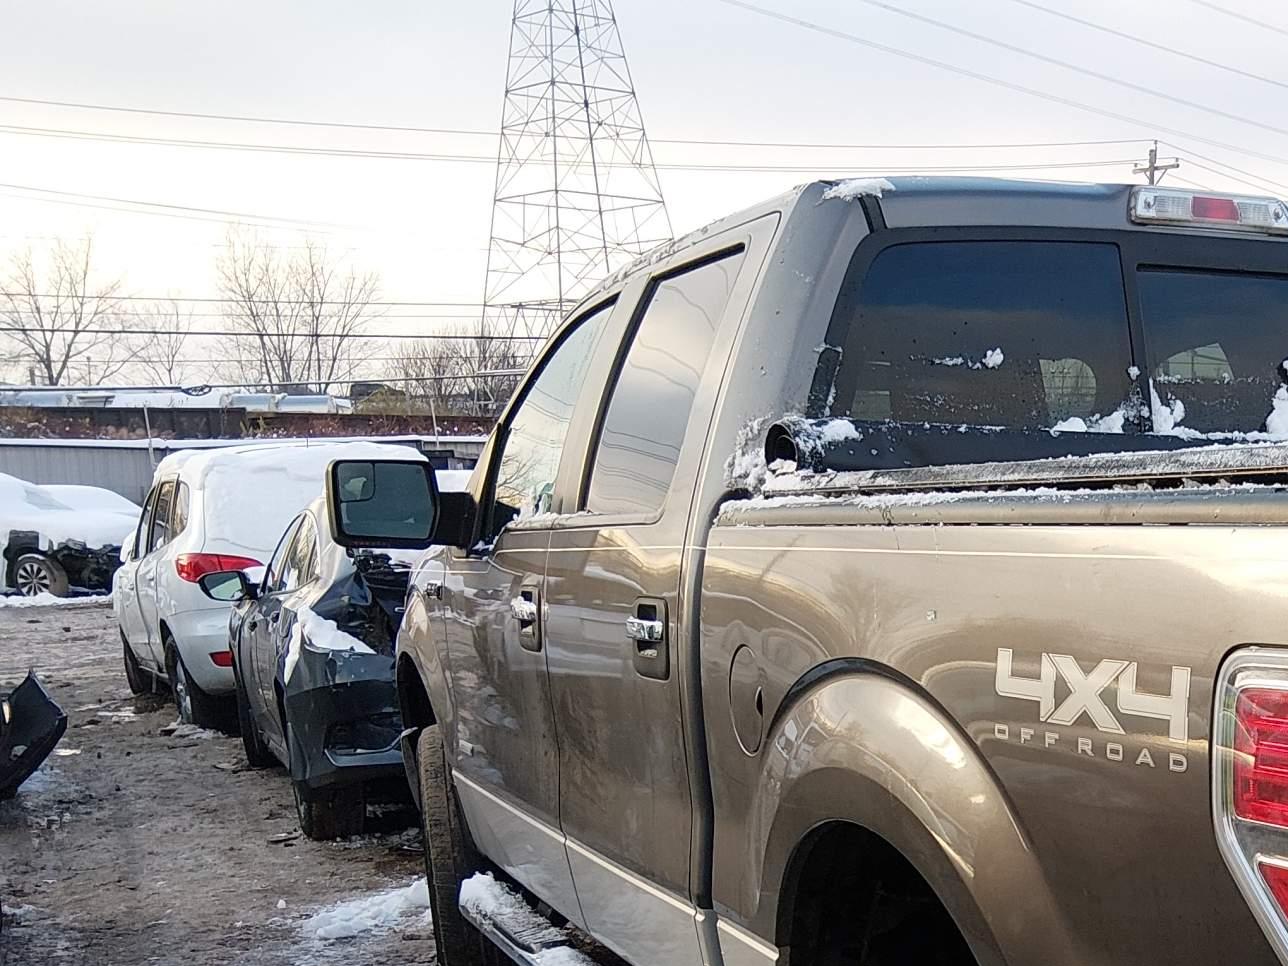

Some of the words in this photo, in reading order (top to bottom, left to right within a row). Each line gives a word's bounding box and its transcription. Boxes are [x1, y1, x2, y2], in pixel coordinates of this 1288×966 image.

[995, 648, 1192, 743] 4X4
[994, 723, 1059, 748] OFF
[1077, 737, 1188, 773] ROAD
